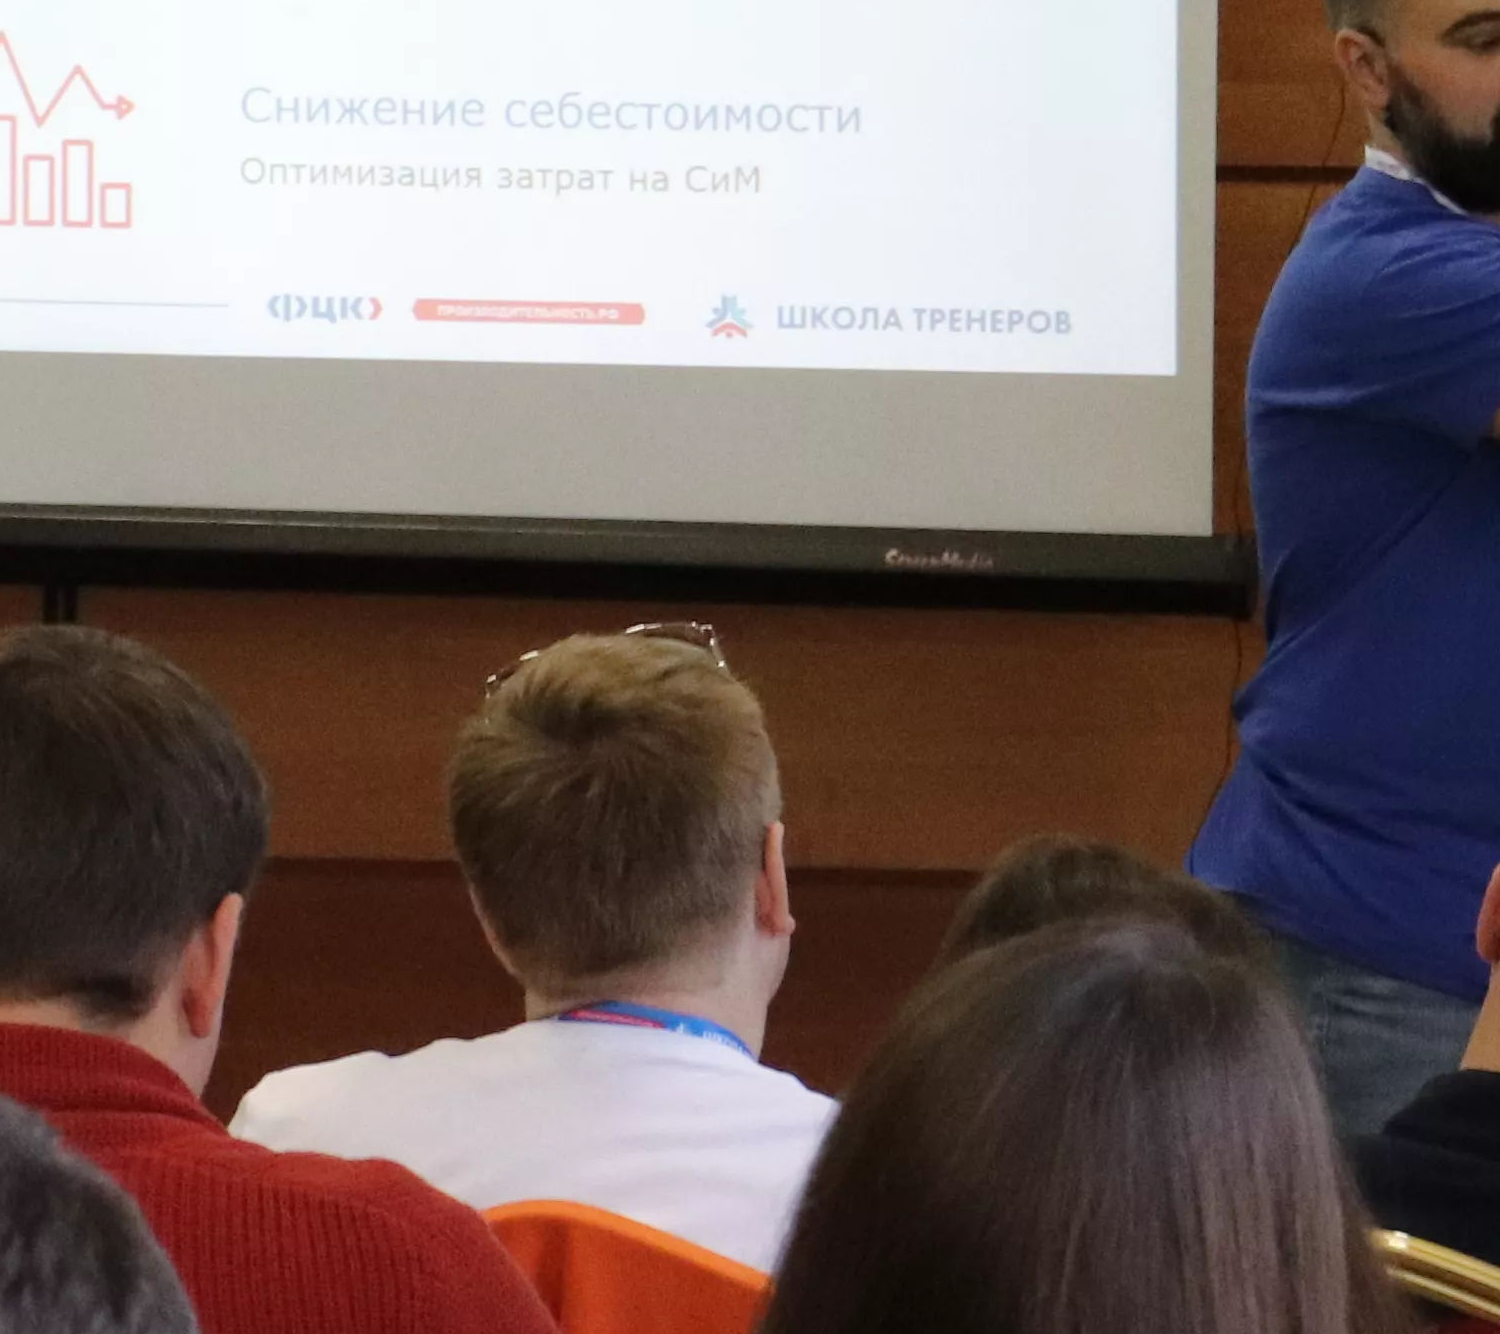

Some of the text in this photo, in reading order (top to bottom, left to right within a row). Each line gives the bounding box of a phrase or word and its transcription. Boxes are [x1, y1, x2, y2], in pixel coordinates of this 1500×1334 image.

[240, 86, 863, 136] Снижение себестоимости
[240, 157, 763, 199] Оптимизация затрат на СиМ
[777, 304, 1074, 336] ШКОЛА ТРЕНЕРОВ
